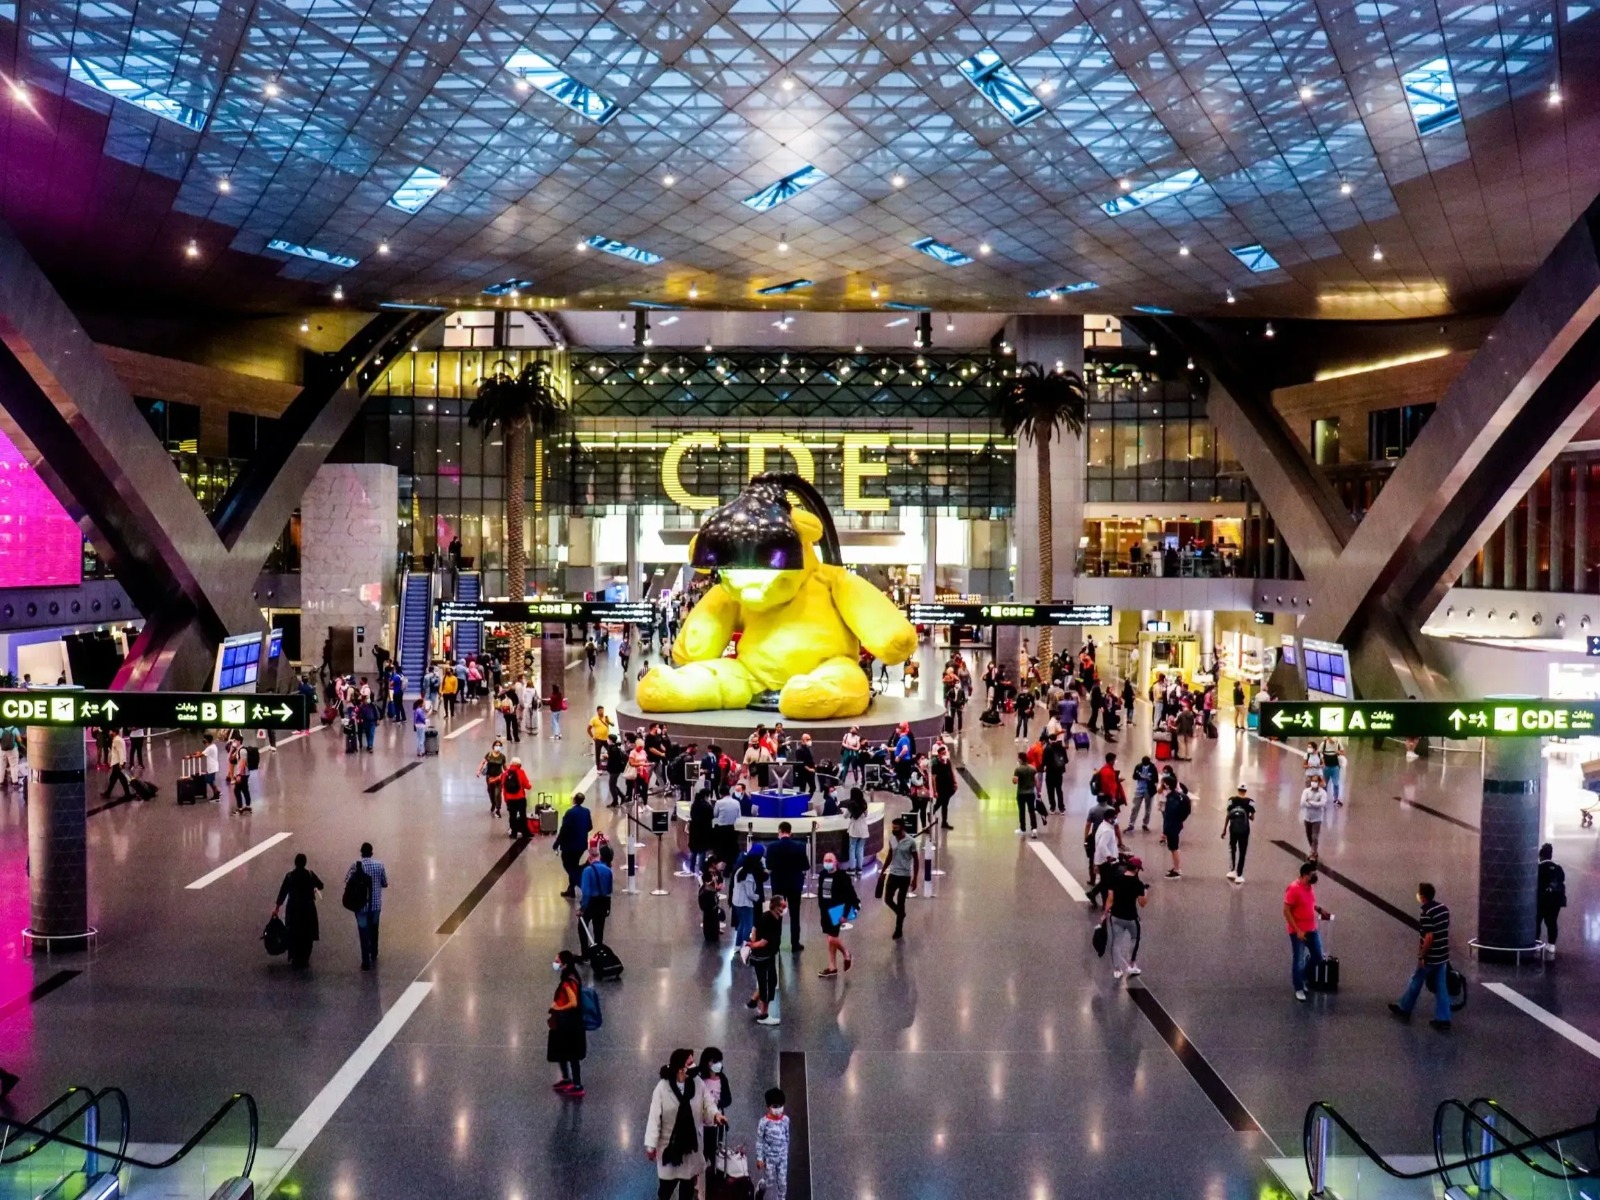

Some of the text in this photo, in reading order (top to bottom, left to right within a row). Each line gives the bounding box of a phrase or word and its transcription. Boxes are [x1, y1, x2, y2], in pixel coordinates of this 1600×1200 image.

[539, 604, 561, 614] CDE
[1002, 607, 1024, 617] CDE
[2, 700, 48, 719] CDE
[201, 702, 218, 721] B
[1348, 710, 1367, 729] A
[1521, 710, 1569, 729] CDE
